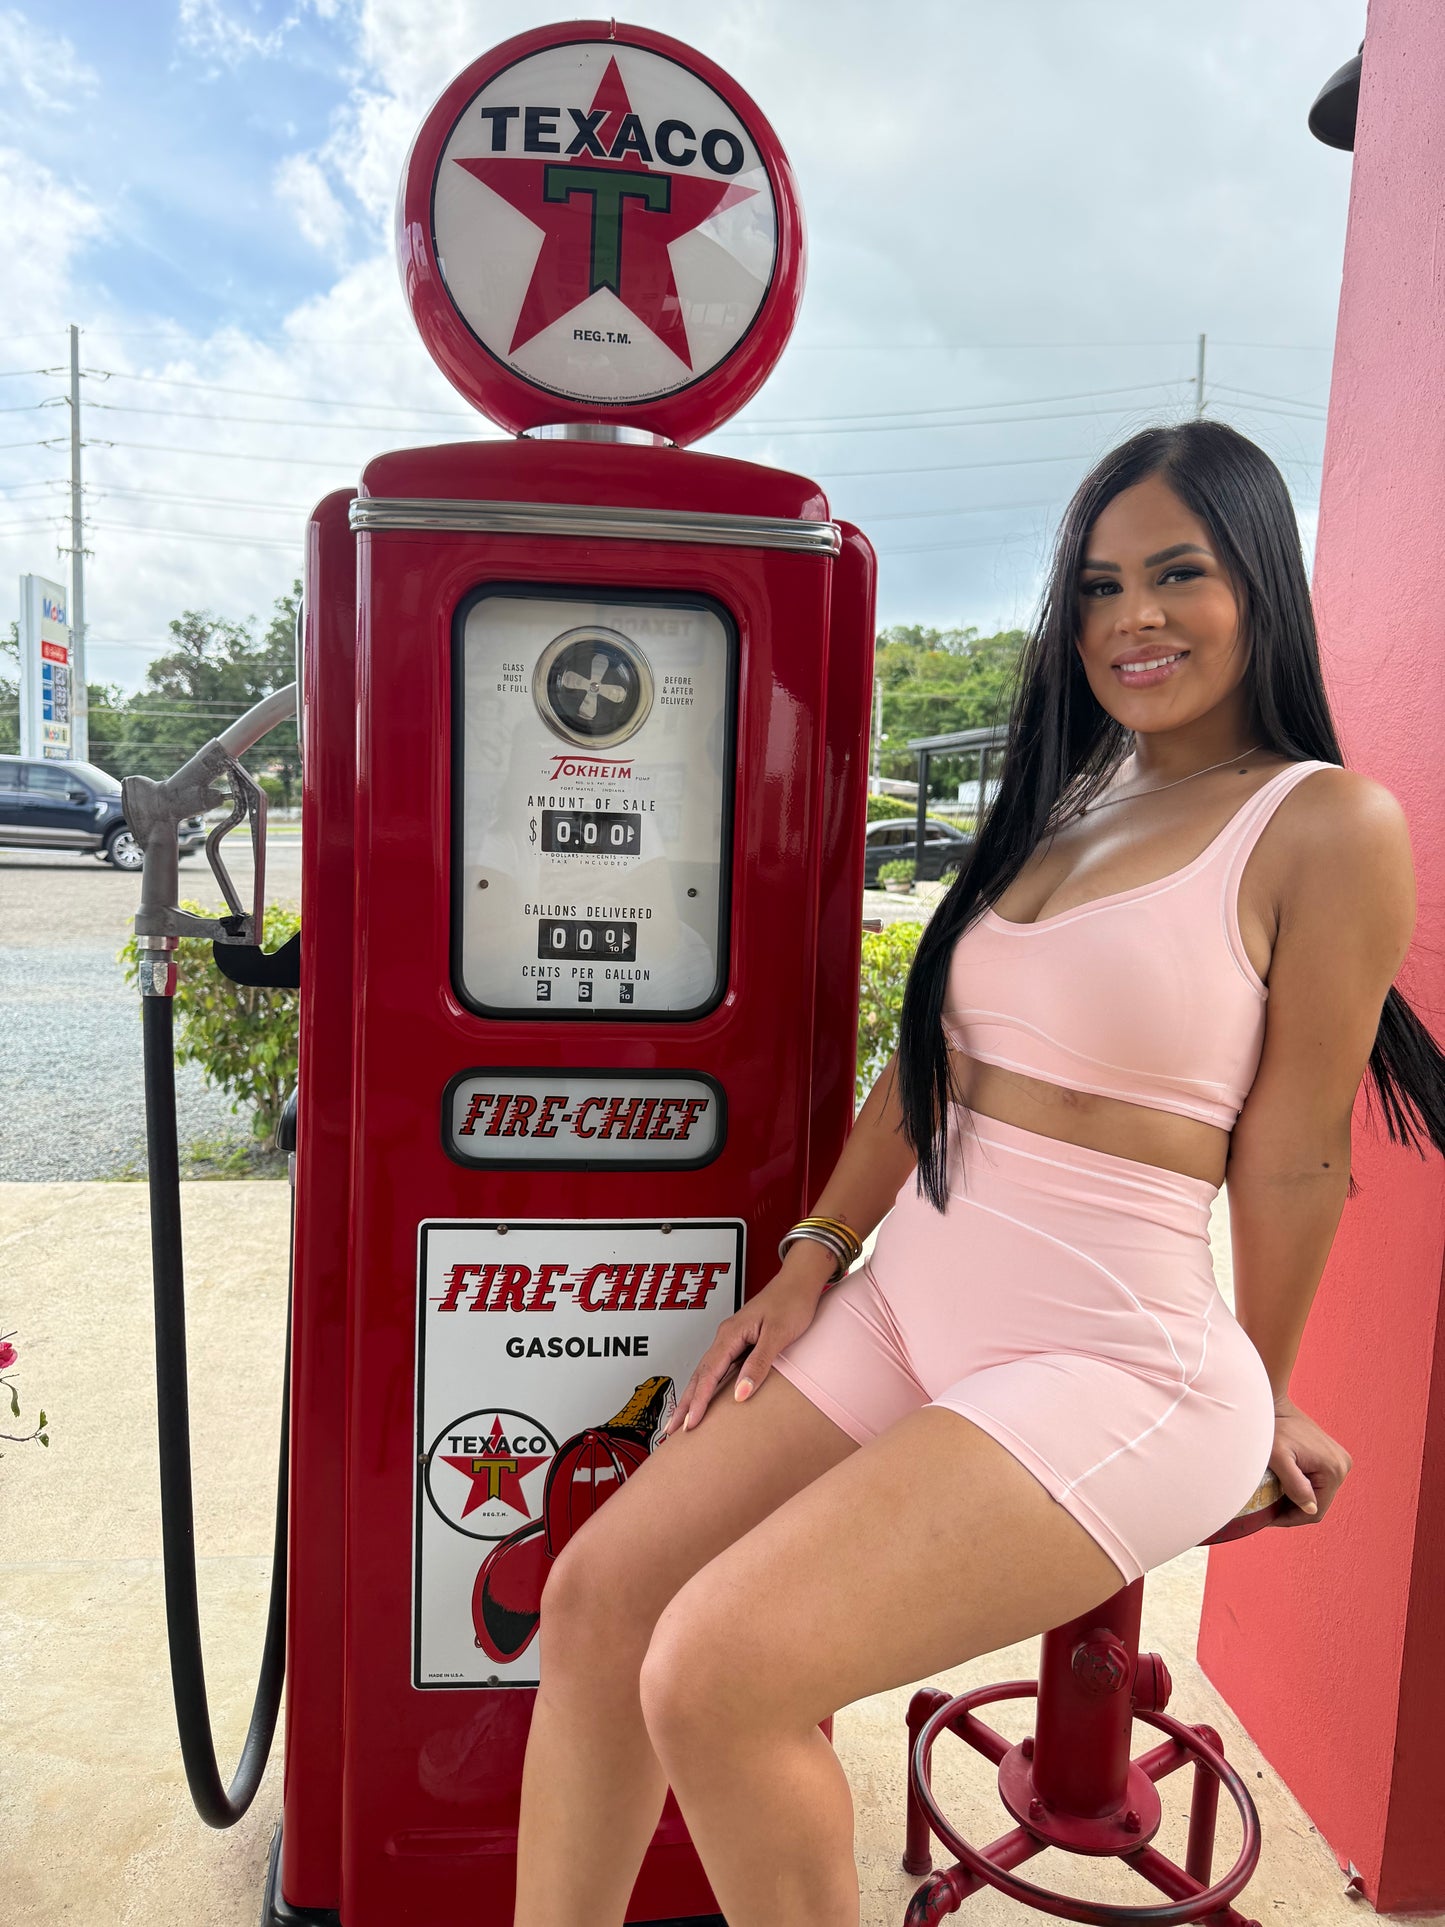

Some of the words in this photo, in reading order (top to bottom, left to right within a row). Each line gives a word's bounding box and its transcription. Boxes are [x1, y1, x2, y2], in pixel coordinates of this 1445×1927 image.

[481, 106, 745, 175] TEXACO
[543, 163, 672, 297] T
[573, 329, 632, 344] REG.T.M.
[502, 663, 525, 672] GLASS
[503, 673, 523, 682] MUST
[664, 676, 692, 686] BEFORE
[497, 684, 507, 692] BE
[509, 685, 528, 693] FULL
[662, 686, 668, 695] &
[670, 687, 694, 696] AFTER
[660, 697, 694, 706] DELIVERY
[549, 755, 635, 781] TOKHEIM
[527, 795, 585, 809] AMOUNT
[595, 798, 611, 809] OF
[623, 800, 656, 812] SALE
[529, 816, 538, 846] $
[524, 903, 577, 917] GALLONS
[586, 906, 652, 919] DELIVERED
[522, 965, 561, 978] CENTS
[571, 967, 594, 979] PER
[605, 969, 650, 981] GALLON
[537, 983, 549, 997] 2
[579, 984, 590, 998] 6
[458, 1094, 709, 1140] FIRE-CHIEF
[436, 1263, 731, 1312] FIRE-CHIEF
[505, 1336, 649, 1358] GASOLINE
[448, 1436, 546, 1454] TEXACO
[472, 1459, 518, 1500] T
